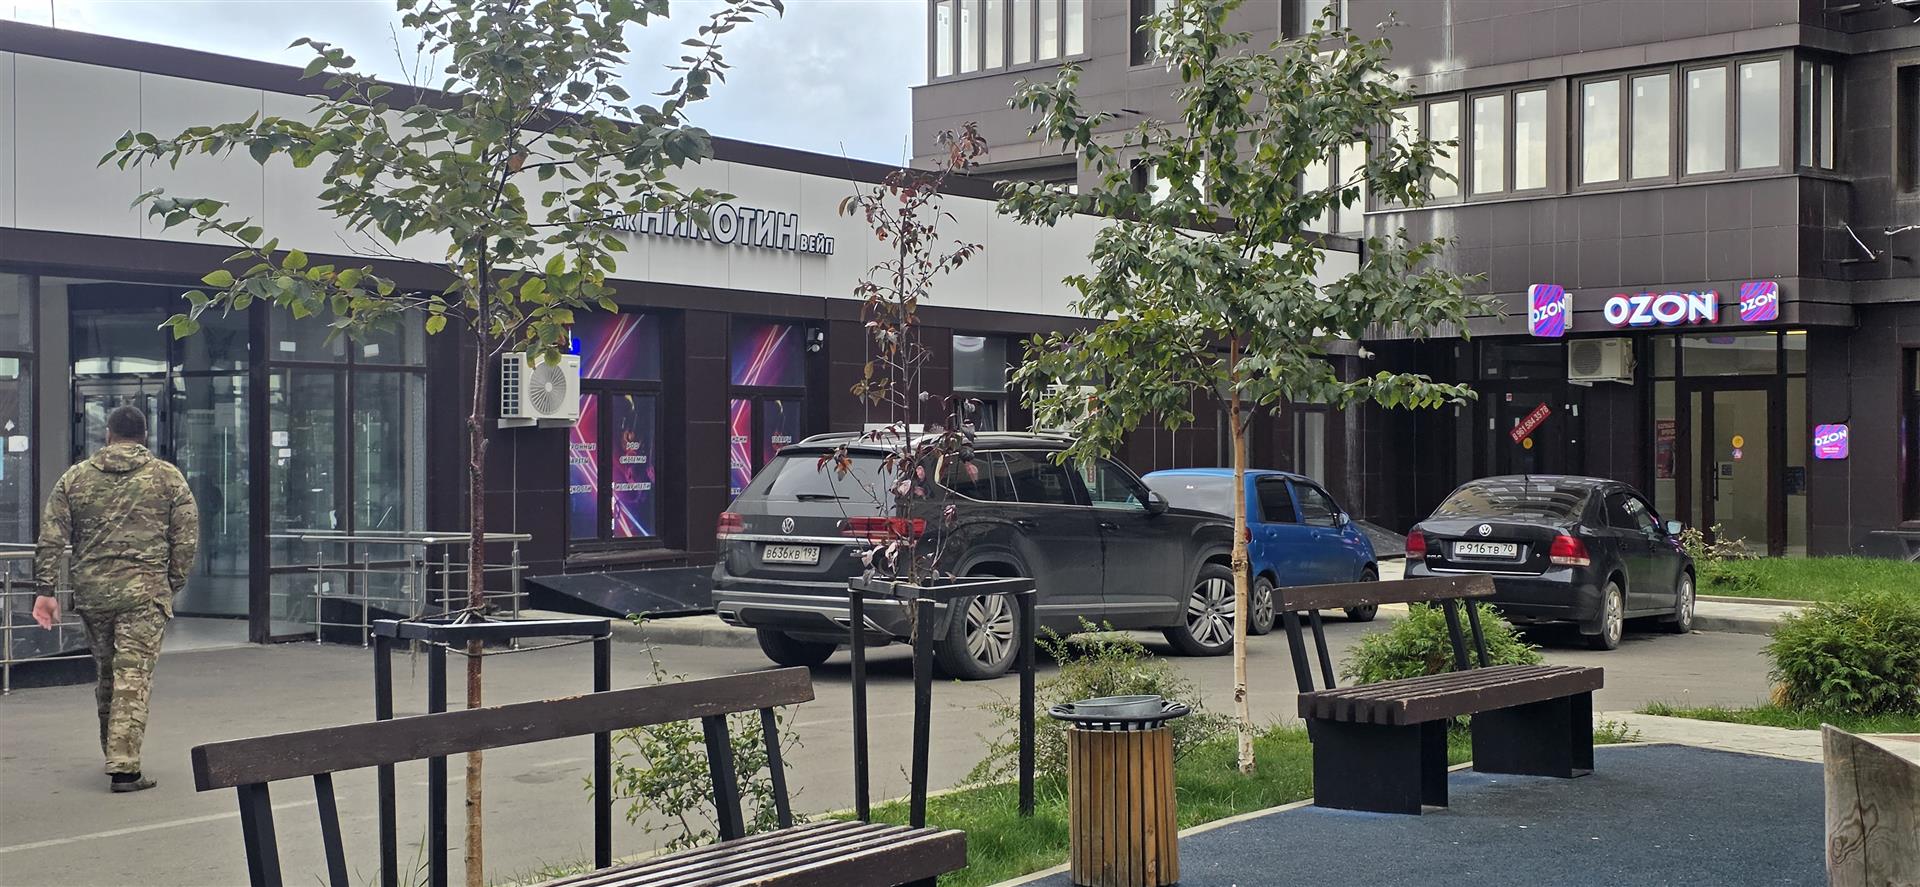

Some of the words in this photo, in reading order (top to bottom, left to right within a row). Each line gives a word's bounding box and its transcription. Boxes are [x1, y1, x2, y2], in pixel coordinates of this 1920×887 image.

[801, 233, 835, 255] ВЕЙП
[1532, 298, 1566, 324] OZON
[1603, 291, 1718, 326] OZON
[1740, 290, 1778, 313] OZON
[1815, 429, 1847, 447] OZON
[802, 547, 818, 558] 193
[1503, 544, 1514, 553] 70
